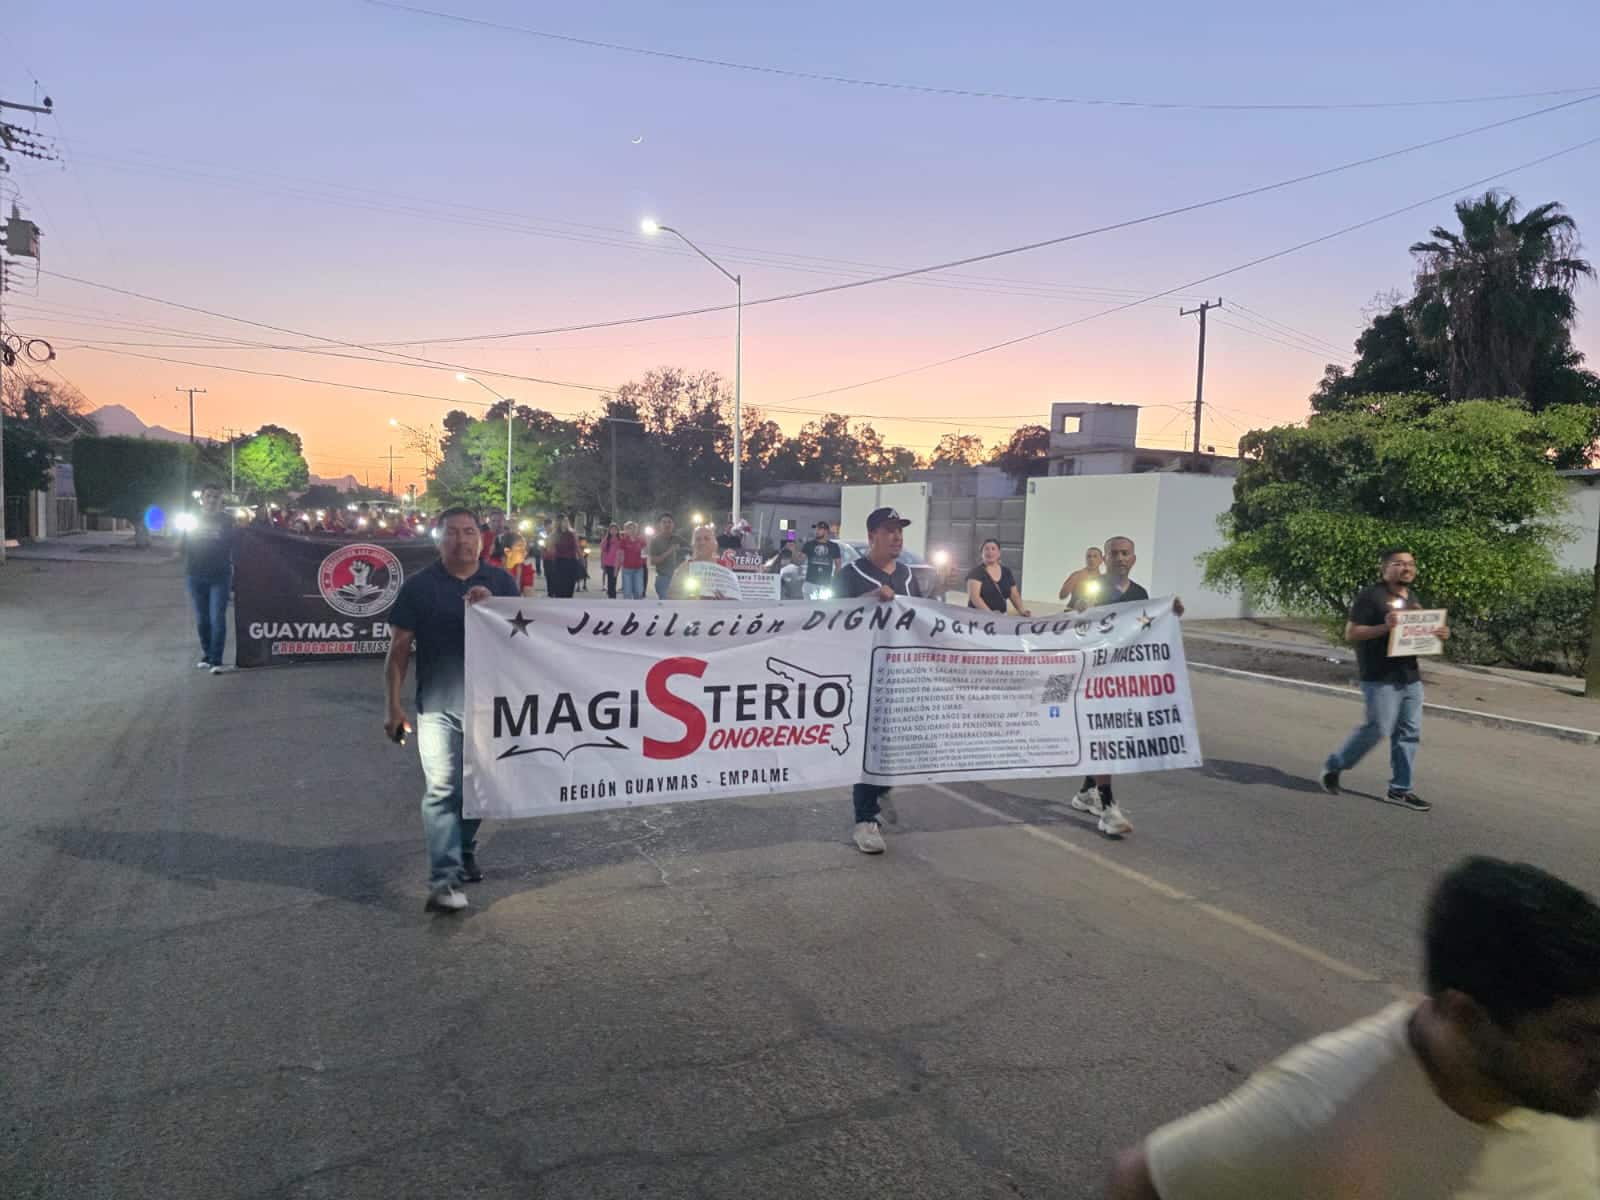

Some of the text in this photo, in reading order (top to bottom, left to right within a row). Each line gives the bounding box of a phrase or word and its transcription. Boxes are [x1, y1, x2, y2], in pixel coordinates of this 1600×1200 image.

[249, 622, 354, 639] GUAYMAS
[566, 611, 786, 637] Jubilación
[801, 606, 916, 632] DIGNA
[930, 615, 996, 637] para
[1110, 643, 1171, 664] MAESTRO
[1085, 673, 1176, 699] LUCHANDO
[1086, 704, 1182, 730] TAMBIÉN ESTÁ
[1090, 735, 1188, 761] ENSEÑANDO!
[559, 778, 617, 803] REGIÓN
[625, 773, 699, 796] GUAYMAS
[719, 767, 790, 787] EMPALME
